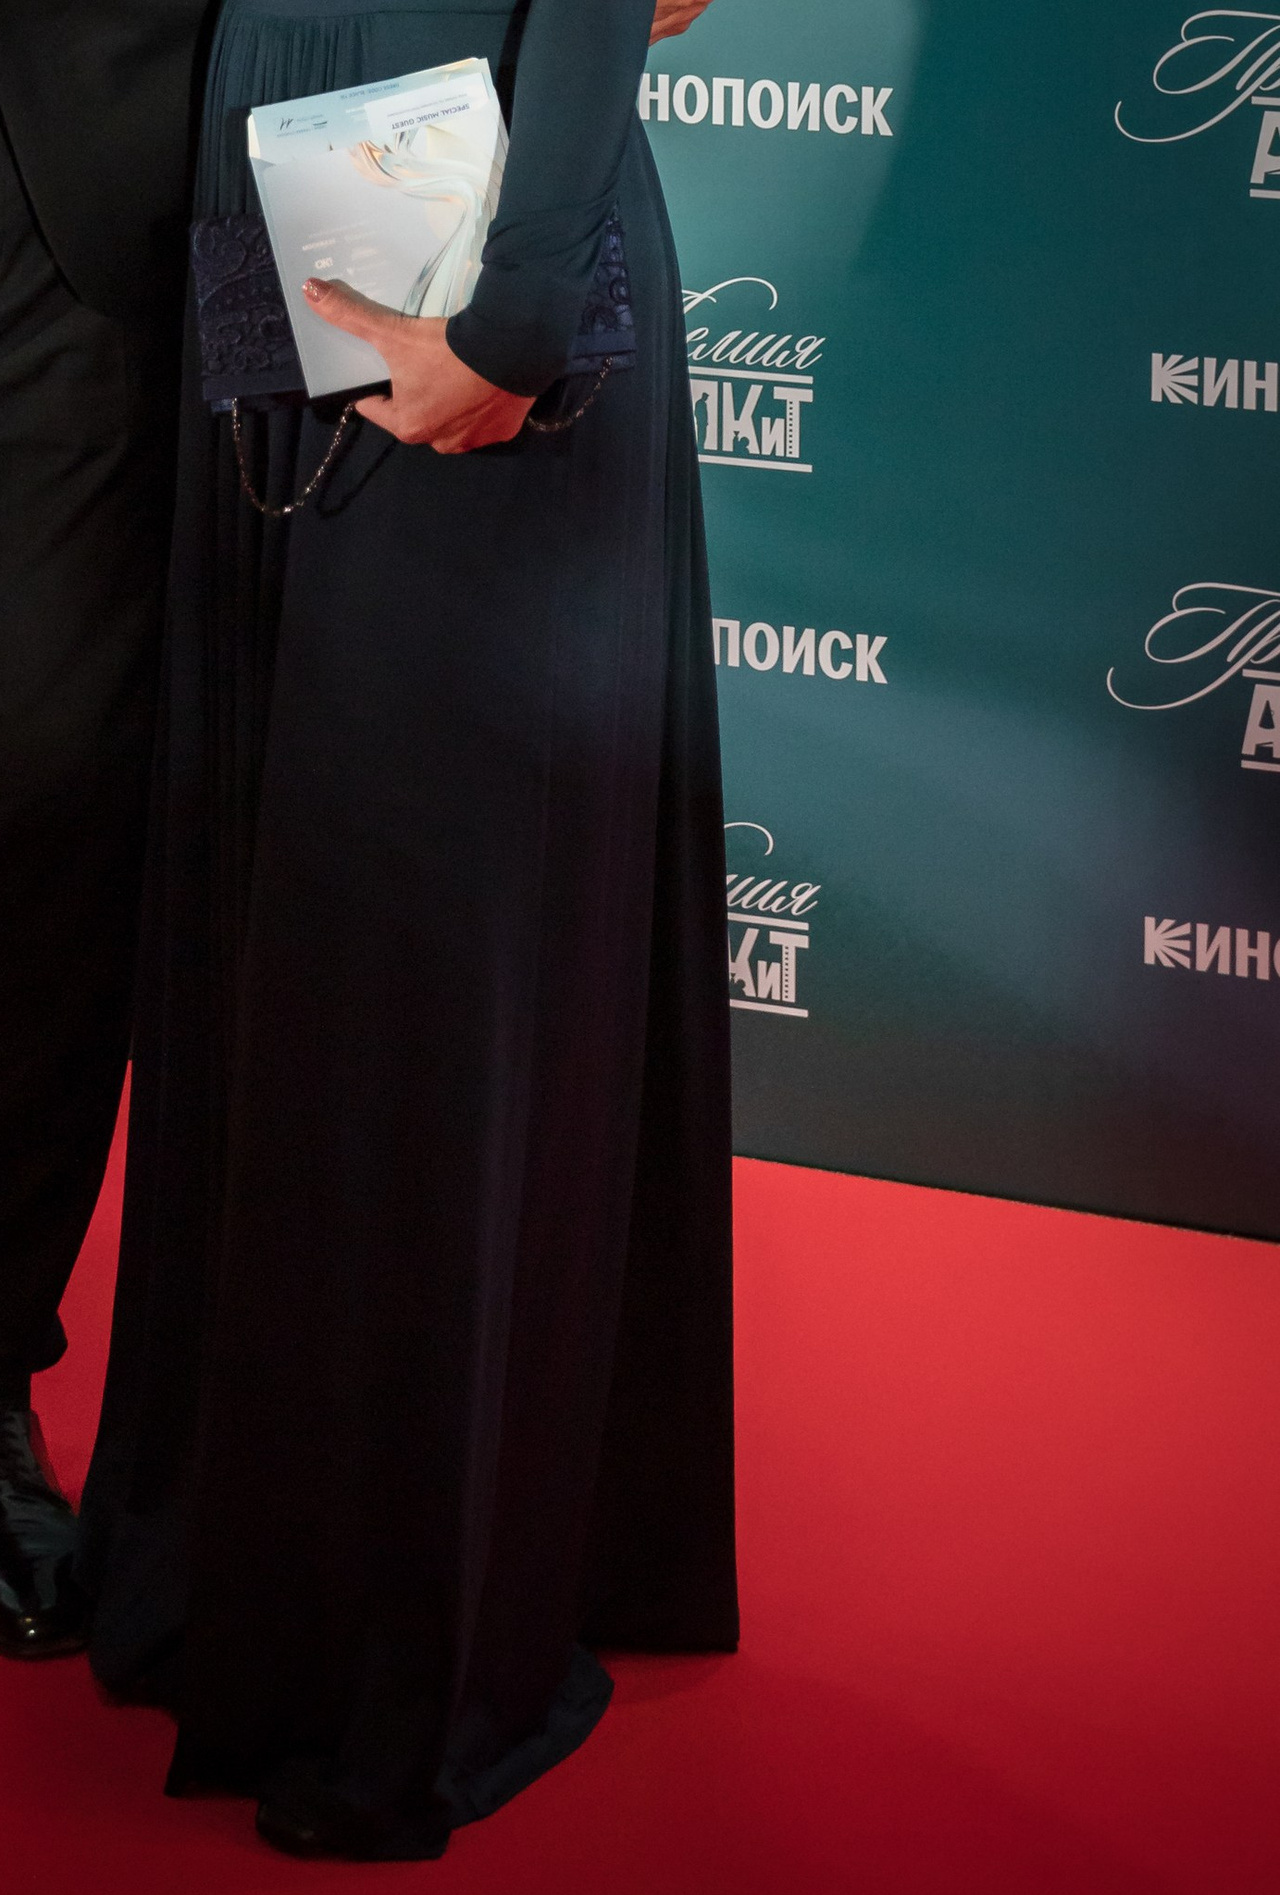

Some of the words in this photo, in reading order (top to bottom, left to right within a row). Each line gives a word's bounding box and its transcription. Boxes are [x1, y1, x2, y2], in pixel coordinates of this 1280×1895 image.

[391, 118, 416, 130] GUEST
[416, 111, 440, 124] MUSIC
[440, 102, 471, 116] SPECIAL
[638, 71, 896, 138] НОПОИСК
[689, 375, 815, 460] ПКиТ
[710, 616, 890, 686] ПОИСК
[727, 926, 811, 1004] КиТ
